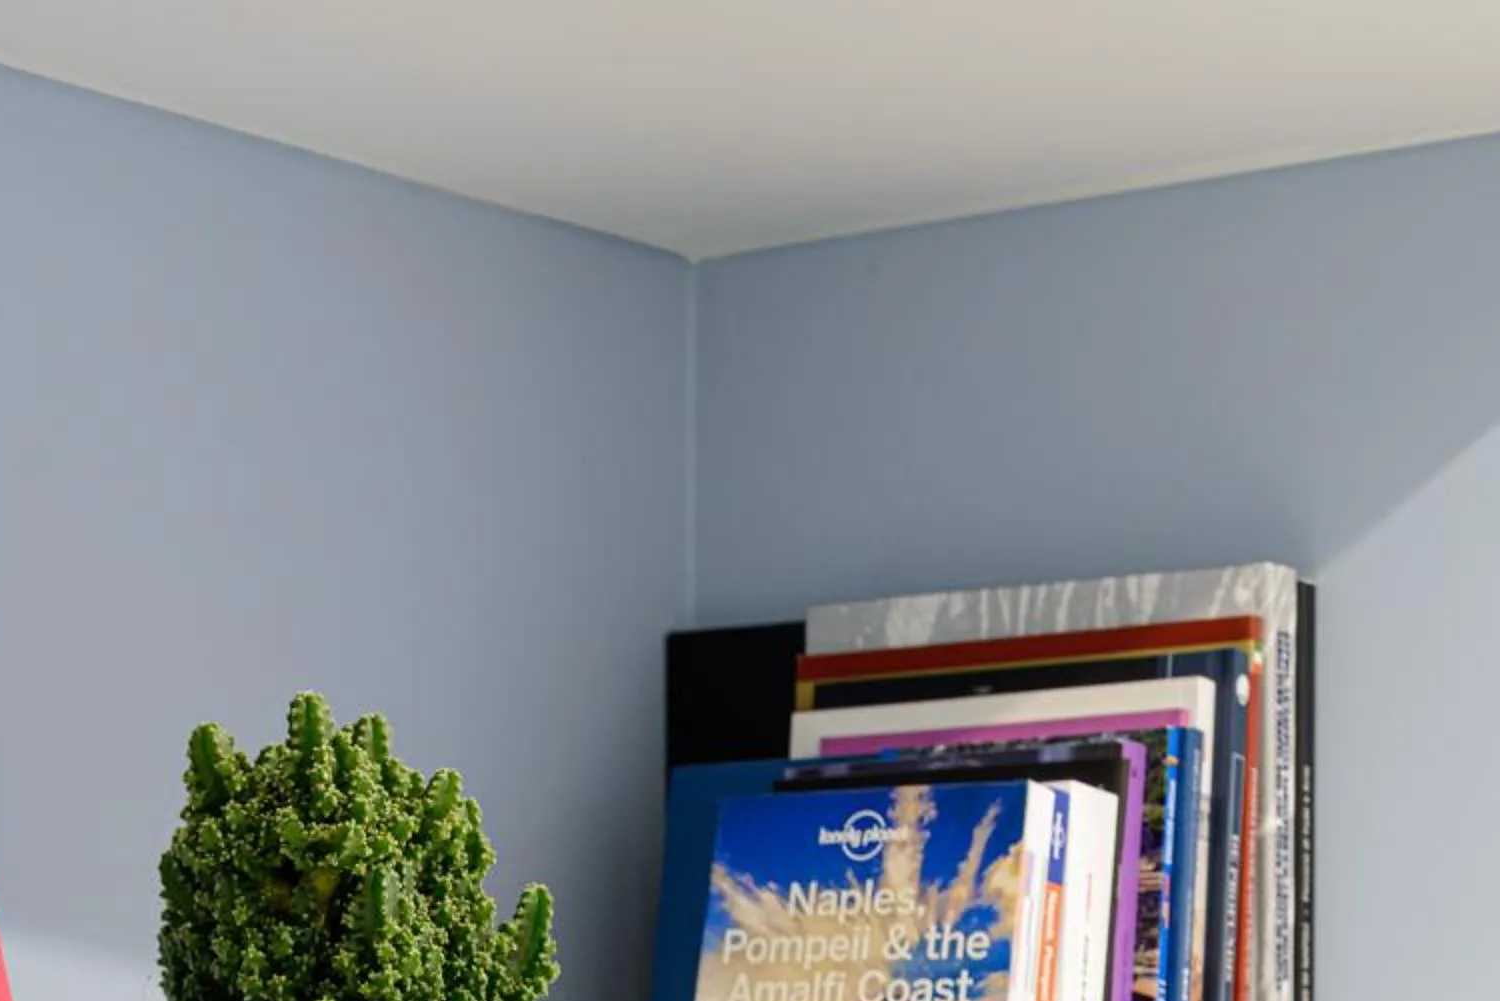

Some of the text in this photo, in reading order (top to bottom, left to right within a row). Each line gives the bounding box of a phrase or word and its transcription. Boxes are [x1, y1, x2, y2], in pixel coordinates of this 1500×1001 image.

[818, 824, 908, 849] lonely planet
[787, 879, 928, 923] Naples,
[721, 923, 991, 970] Pompeii & the
